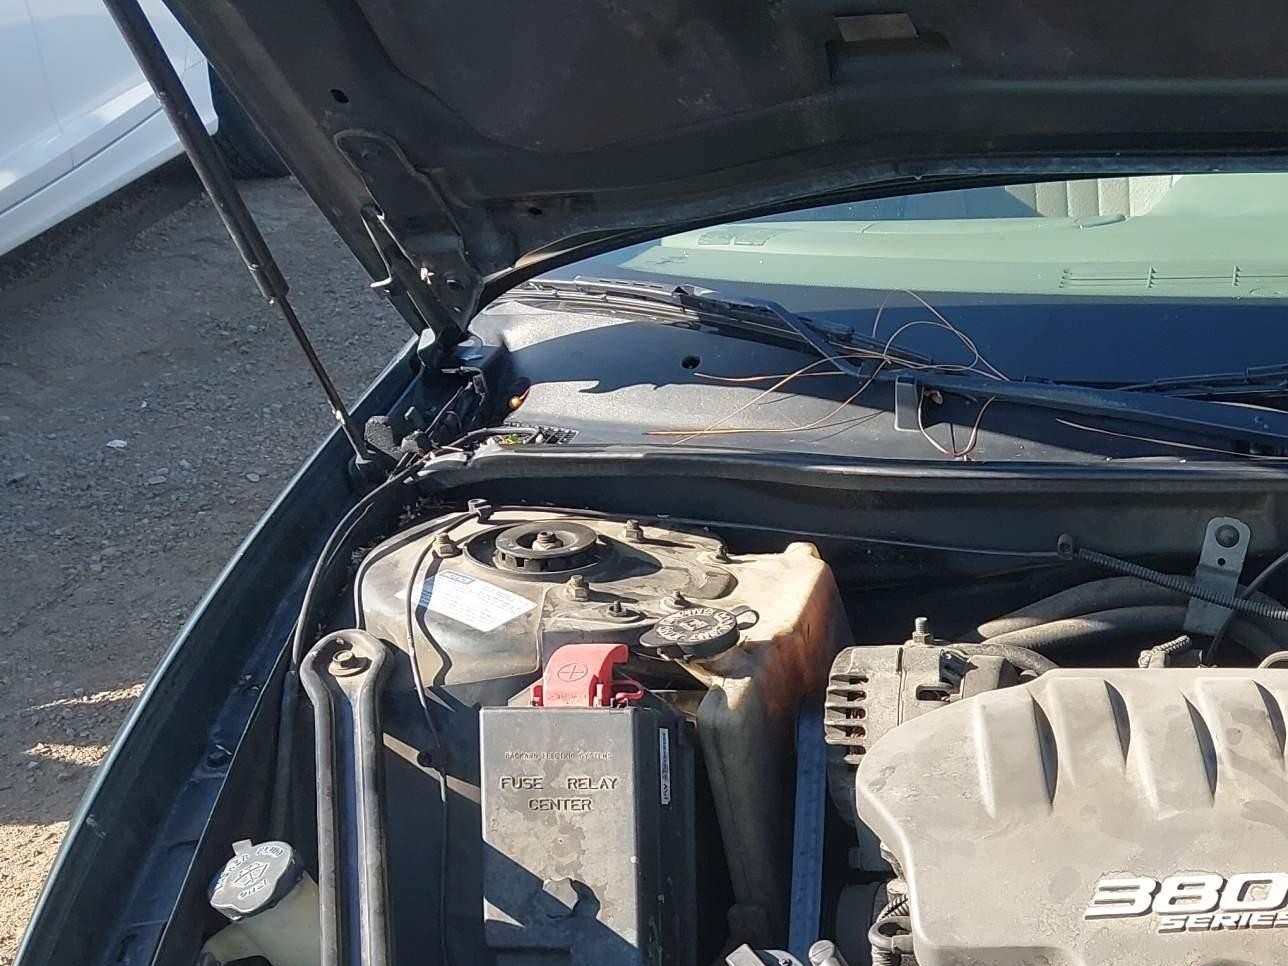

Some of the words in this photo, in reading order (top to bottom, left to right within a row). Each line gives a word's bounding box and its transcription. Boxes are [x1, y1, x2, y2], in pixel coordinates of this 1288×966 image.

[500, 775, 544, 790] FUSE
[566, 775, 618, 790] RELAY
[528, 797, 592, 811] CENTER
